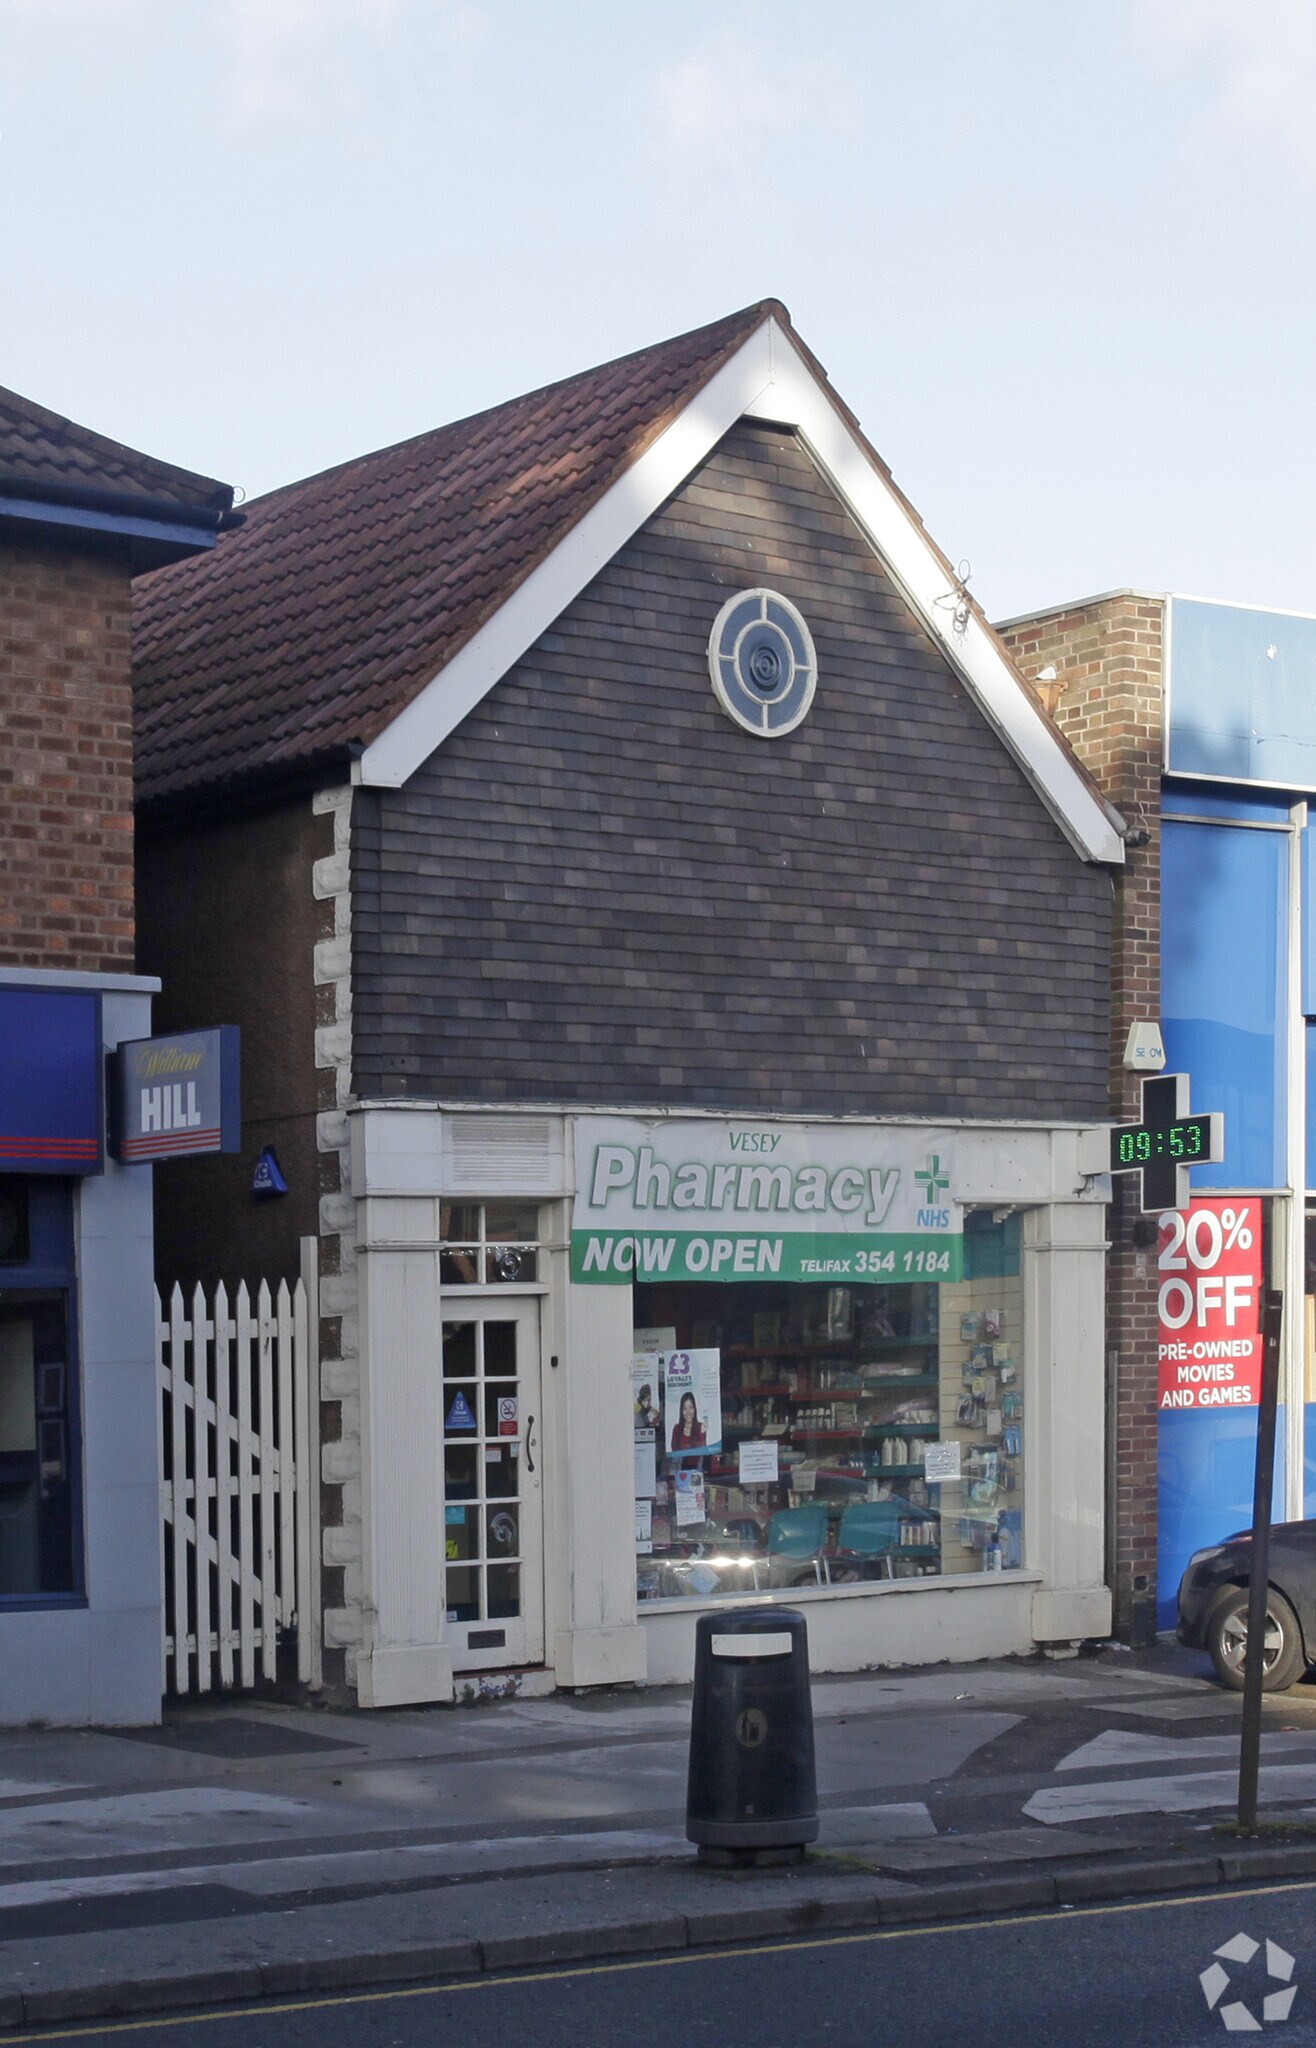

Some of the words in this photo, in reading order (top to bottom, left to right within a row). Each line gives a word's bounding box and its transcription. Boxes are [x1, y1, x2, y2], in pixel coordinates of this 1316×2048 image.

[141, 1081, 201, 1133] HILL
[729, 1131, 782, 1153] VESEY
[1120, 1125, 1201, 1162] 09:53
[588, 1144, 901, 1226] Pharmacy
[916, 1208, 951, 1228] NHS
[1158, 1208, 1253, 1270] 20%
[582, 1237, 676, 1273] NOW
[685, 1238, 783, 1273] OPEN
[855, 1250, 896, 1273] 354
[903, 1250, 950, 1273] 1184
[1157, 1275, 1253, 1330] OFF
[668, 1353, 690, 1375] £3
[1158, 1339, 1254, 1361] PRE-OWNED
[1177, 1363, 1235, 1384] MOVIES
[1161, 1389, 1195, 1408] AND
[1198, 1386, 1252, 1405] GAMES
